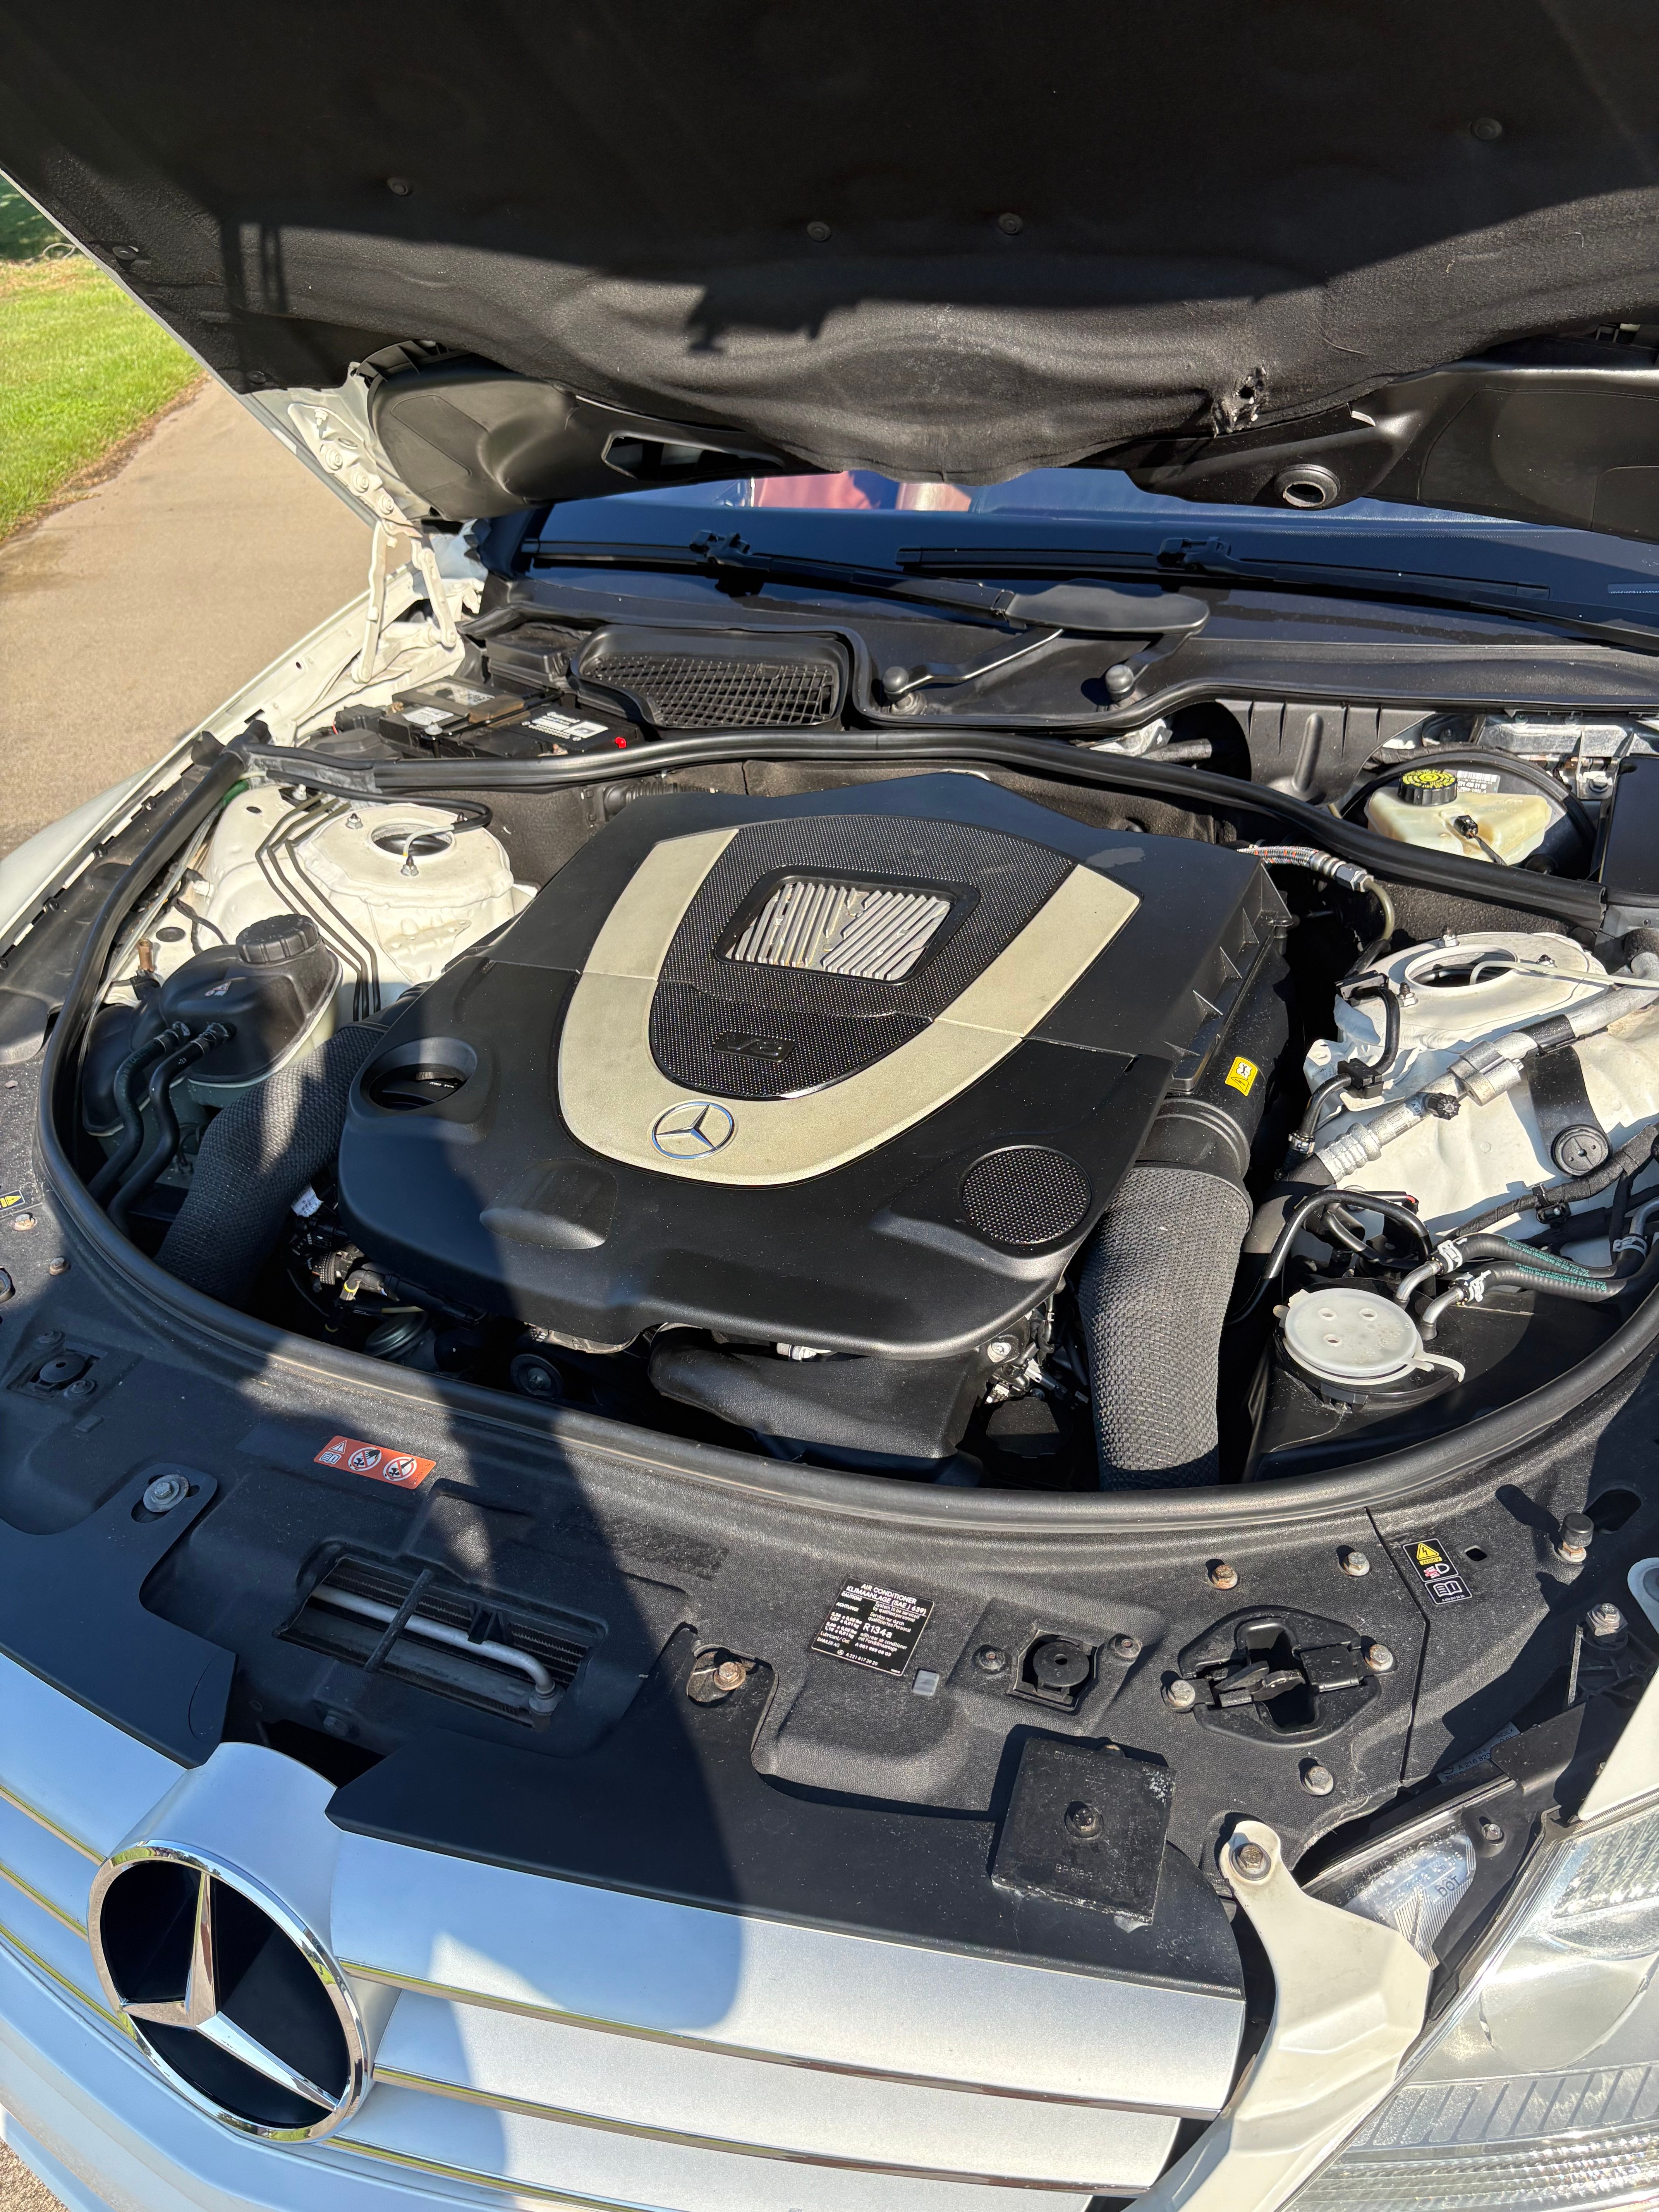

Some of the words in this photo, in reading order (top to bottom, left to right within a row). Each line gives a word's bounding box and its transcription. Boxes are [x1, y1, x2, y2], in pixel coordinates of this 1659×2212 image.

[841, 1592, 862, 1602] CAUTION!
[846, 1585, 892, 1604] KLIMAANLAGE
[891, 1599, 907, 1609] (SAE
[911, 1605, 927, 1615] 639)
[873, 1587, 917, 1605] CONDITIONER
[836, 1601, 859, 1612] ACHTUNG!
[874, 1602, 891, 1611] System
[902, 1611, 920, 1619] serviced
[869, 1612, 886, 1620] Service
[878, 1608, 896, 1617] qualified
[895, 1613, 915, 1623] personnel
[862, 1622, 893, 1639] R134a
[893, 1624, 911, 1633] Personal
[884, 1640, 908, 1650] conditioner
[1053, 1750, 1096, 1769] SIMPSON
[1465, 1758, 1478, 1768] 216
